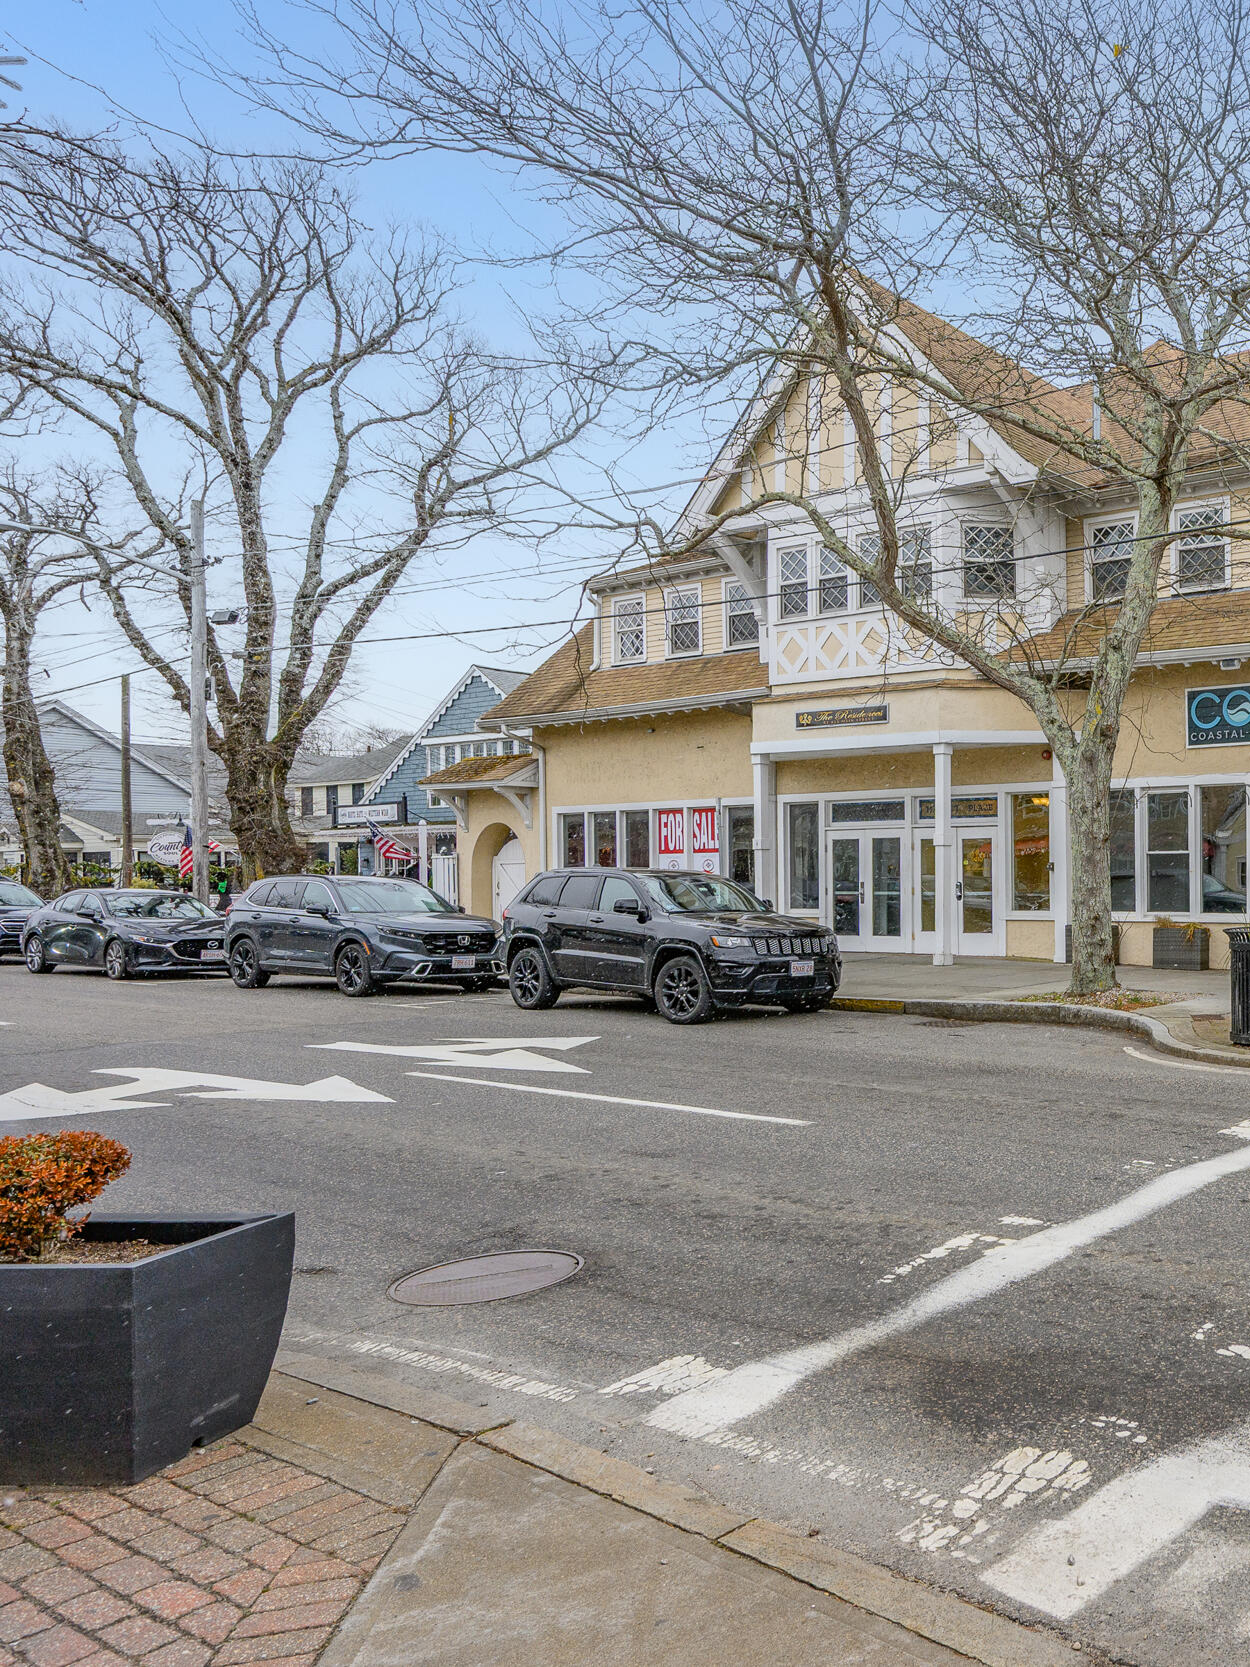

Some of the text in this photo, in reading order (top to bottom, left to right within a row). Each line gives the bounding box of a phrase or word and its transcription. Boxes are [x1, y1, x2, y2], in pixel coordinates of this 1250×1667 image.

[815, 711, 833, 722] The
[1190, 729, 1246, 741] COASTAL
[660, 812, 684, 851] FOR
